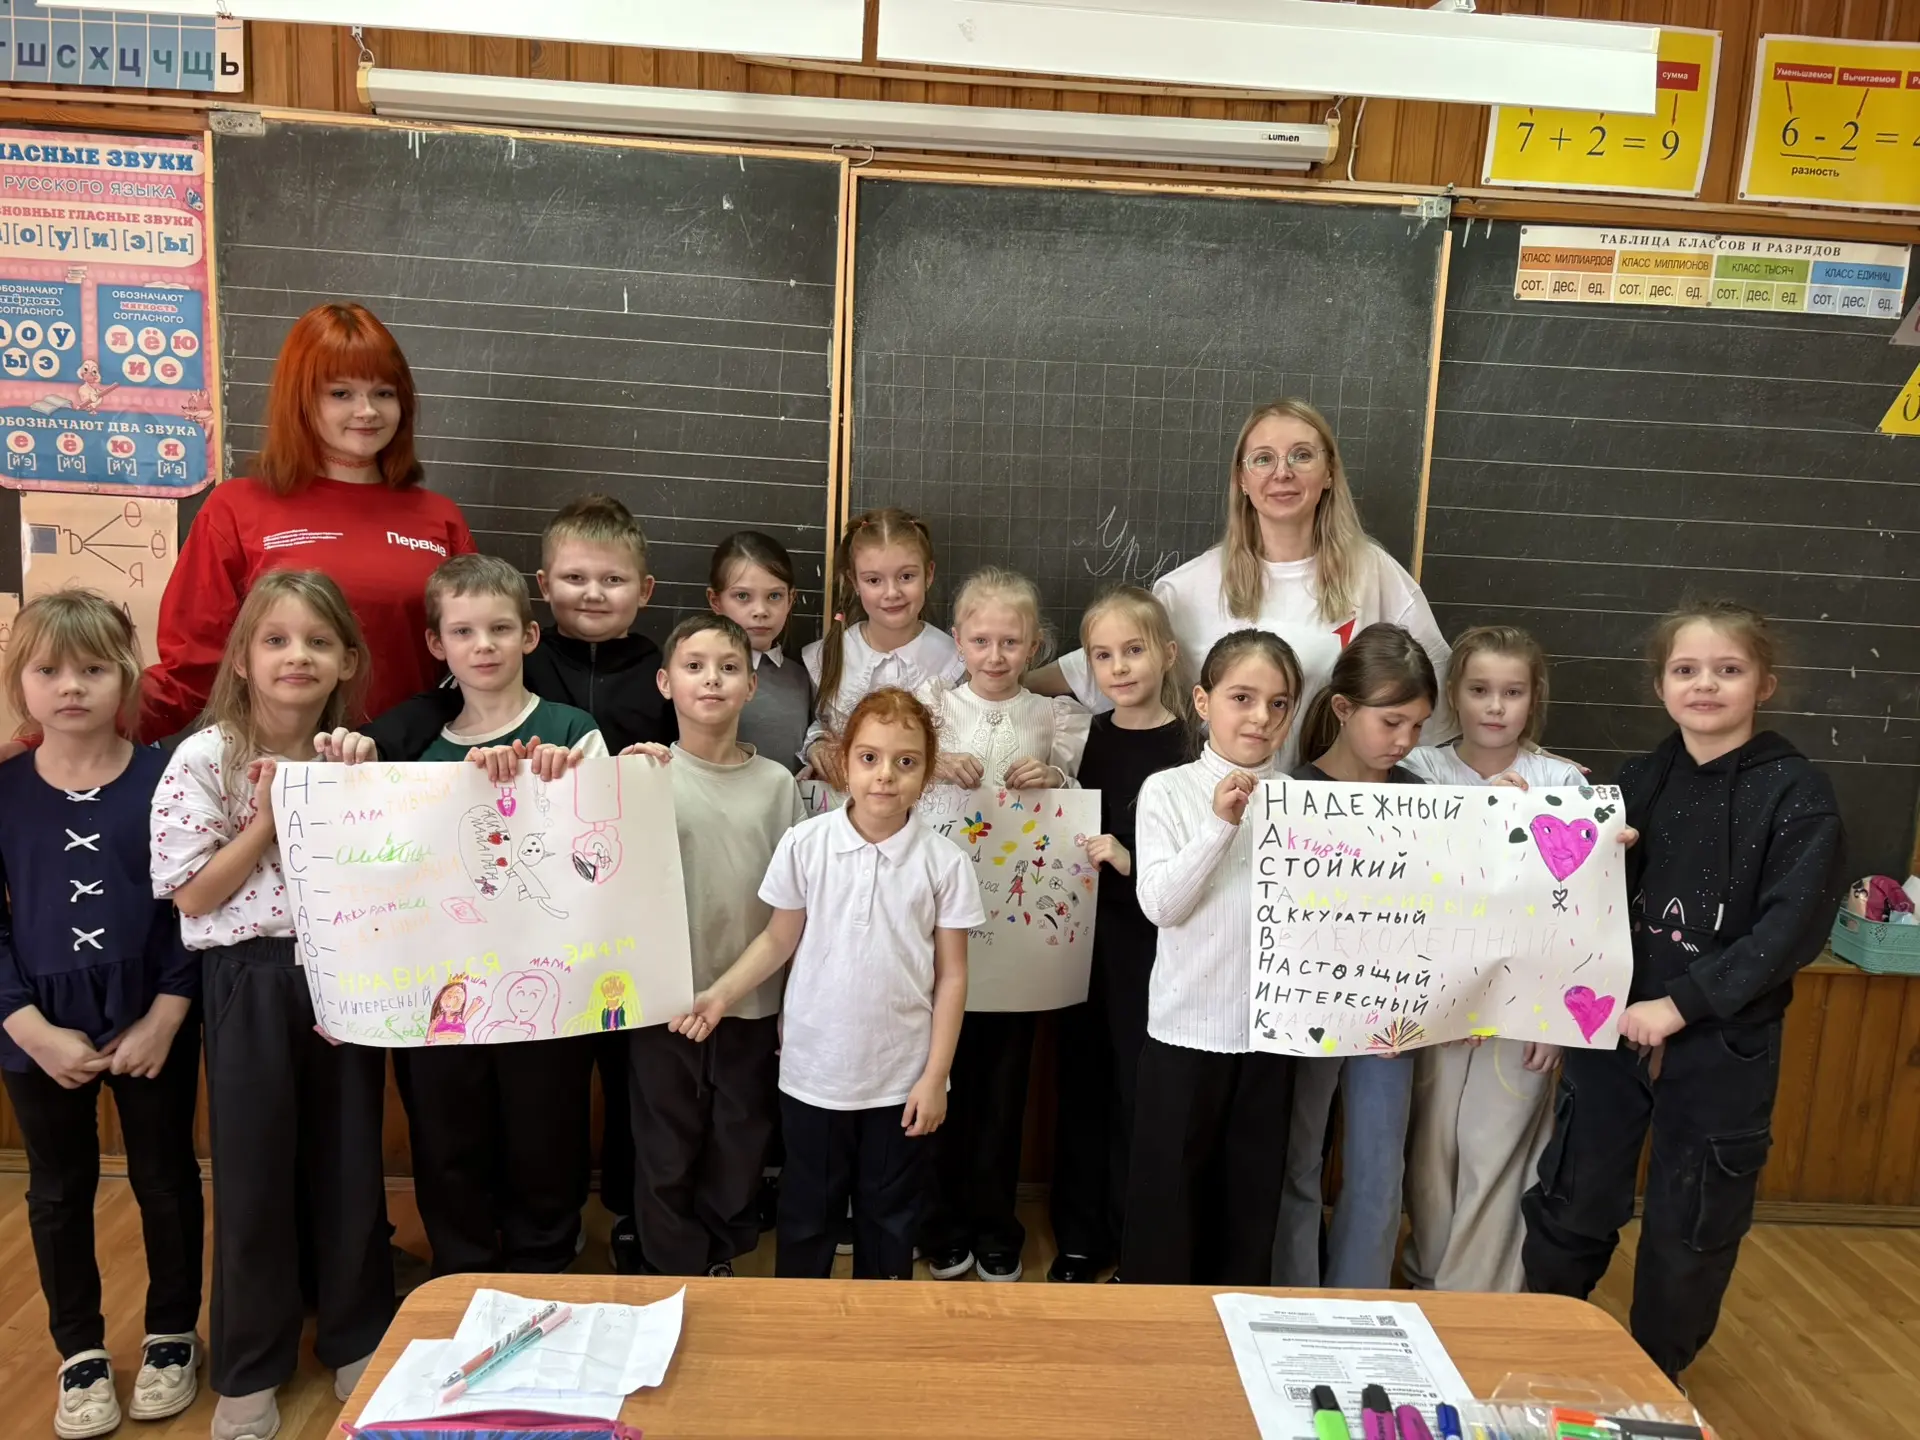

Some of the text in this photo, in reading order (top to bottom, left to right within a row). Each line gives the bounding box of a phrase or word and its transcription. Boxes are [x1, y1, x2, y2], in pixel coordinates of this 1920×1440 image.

[1661, 71, 1689, 82] сумма
[1776, 67, 1896, 84] Уменьшаемое Вычитаемое
[1517, 122, 1535, 152] 7
[1586, 125, 1607, 157] 2
[1660, 130, 1680, 161] 9
[1782, 116, 1800, 147] 6
[1840, 121, 1860, 151] 2
[106, 149, 193, 171] ЗВУКИ
[1791, 166, 1840, 178] разность
[4, 175, 176, 199] РУССКОГО ЯЗЫКА
[0, 205, 193, 227] НОВНЫЕ ГЛАСНЫЕ ЗВУКИ
[1600, 233, 1841, 257] ТАБЛИЦА КЛАССОВ И РАЗРЯДОВ
[1521, 253, 1613, 267] КЛАСС МИЛЛИАРДОВ
[1622, 257, 1709, 271] КЛАСС МИЛЛИОНОВ
[1732, 262, 1794, 275] КЛАСС ТЫСЯЧ
[1824, 268, 1891, 282] КЛАСС ЕДИНИЦ
[0, 284, 64, 295] БОЗНАЧАЮТ
[1521, 279, 1605, 295] сот. дес. ед.
[1619, 283, 1702, 299] сот. дес. ед.
[1716, 287, 1798, 304] сот. дес. ед.
[112, 290, 184, 302] ОБОЗНАЧАЮТ
[1813, 293, 1893, 310] сот. дес. ед.
[120, 301, 178, 313] мягкость
[113, 312, 184, 324] СОГЛАСНОГО
[107, 423, 141, 434] ДВА
[144, 424, 198, 437] ЗВУКА
[386, 531, 446, 557] Первые
[1265, 781, 1465, 821] НАДЕЖНЫЙ
[1260, 851, 1408, 880] СТОЙКИЙ
[1258, 951, 1432, 988] НАСТОЯЩИЙ
[1255, 981, 1430, 1016] ИНТЕРЕСНЫЙ
